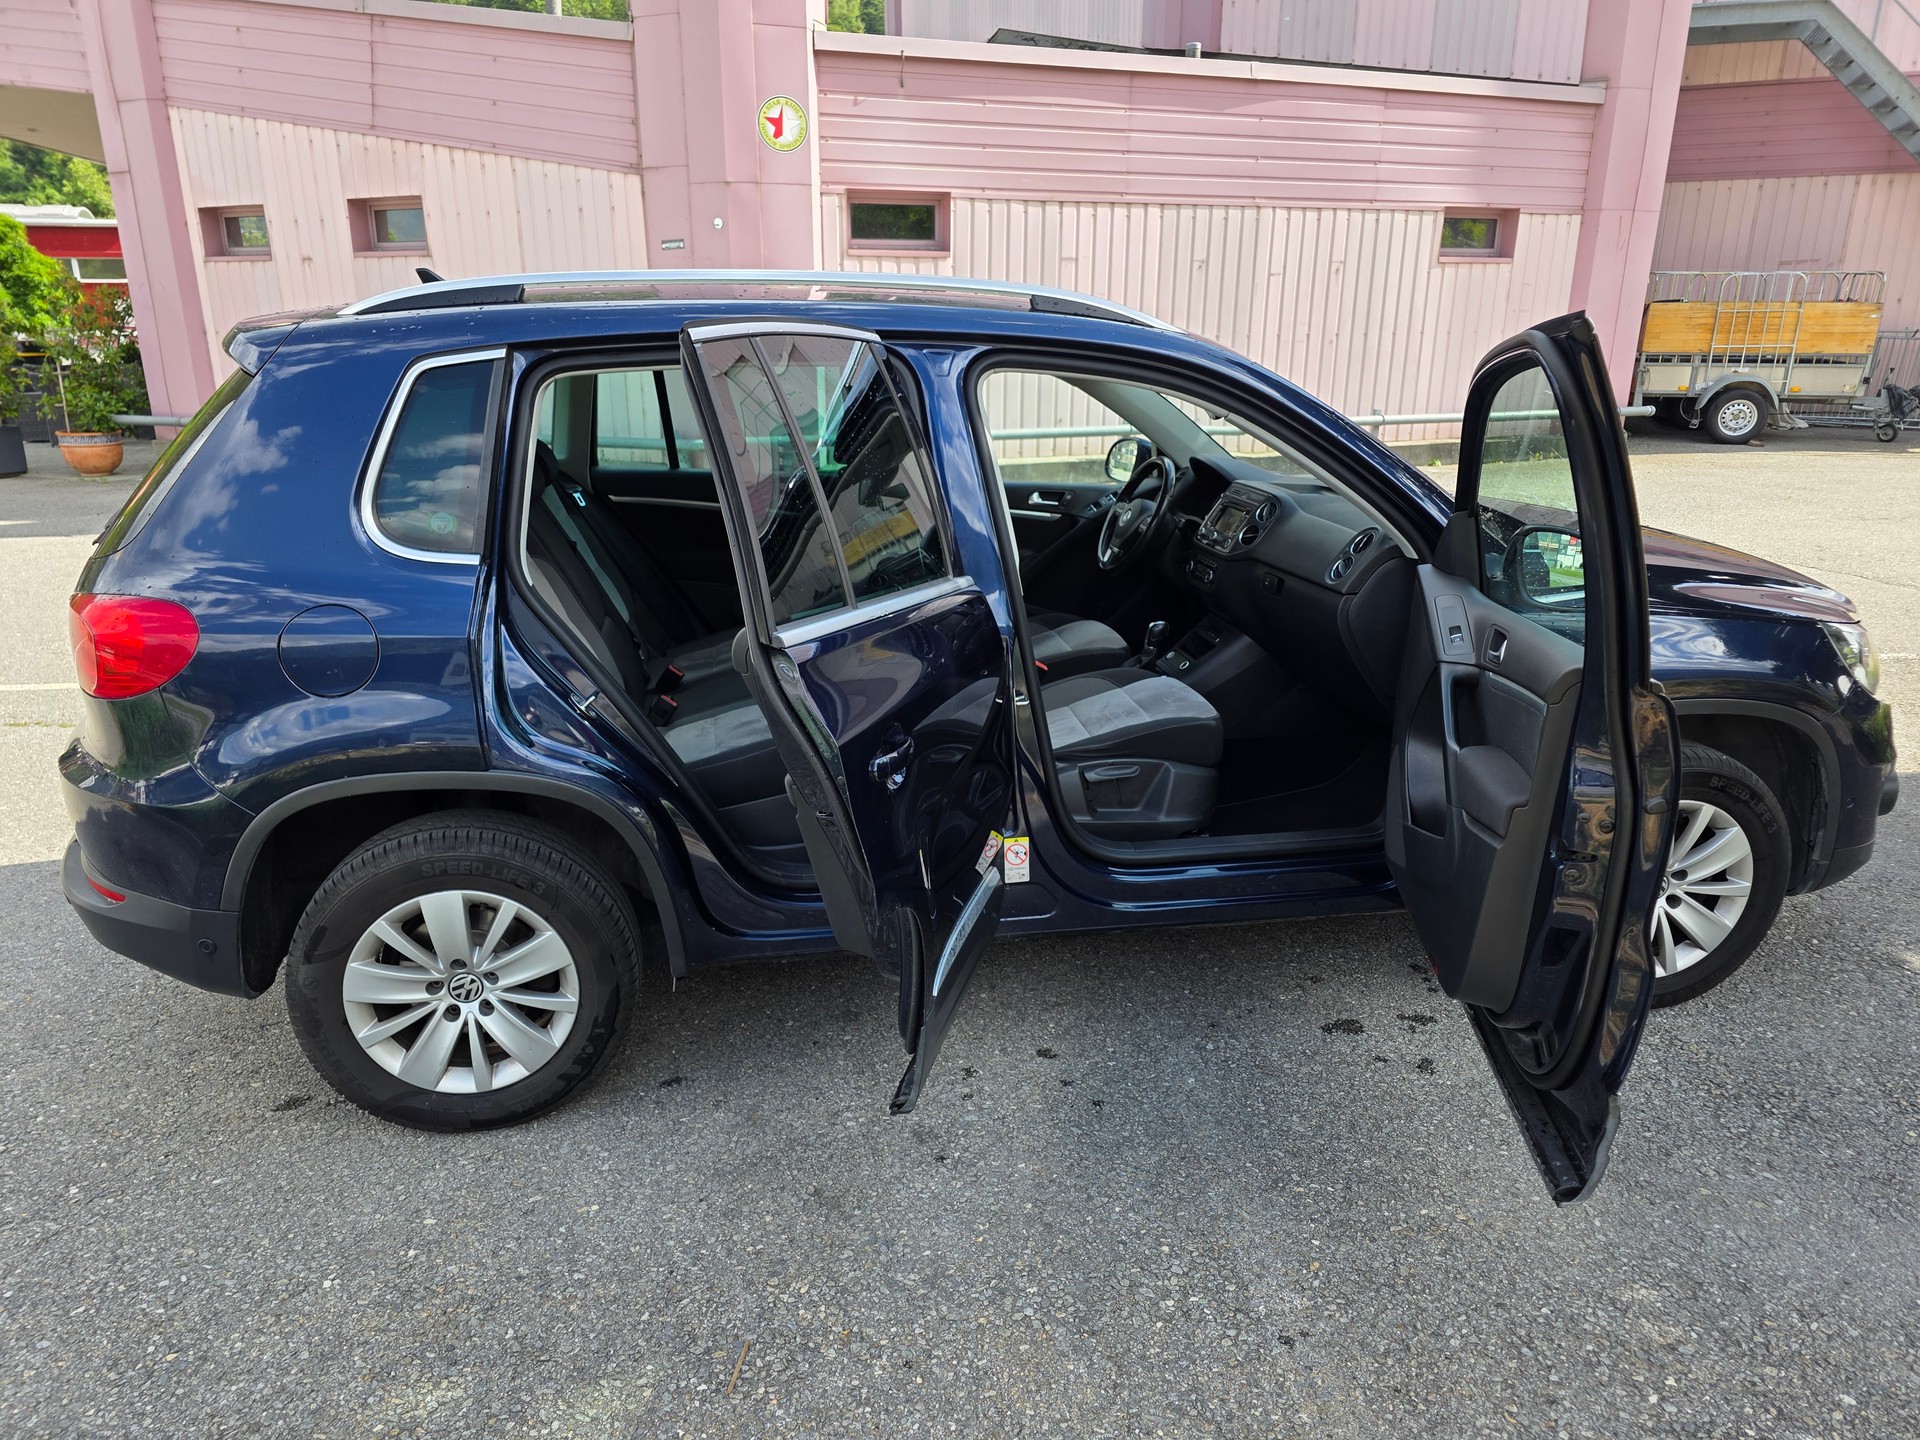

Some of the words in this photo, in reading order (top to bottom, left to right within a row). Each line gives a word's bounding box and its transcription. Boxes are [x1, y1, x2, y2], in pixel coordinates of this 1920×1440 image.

[766, 99, 781, 110] STAR
[784, 100, 800, 114] KIDS
[1708, 775, 1773, 824] SPEED-LIFE
[1767, 822, 1778, 834] 3
[421, 860, 531, 888] SPEED-LIFE
[533, 881, 546, 895] 3
